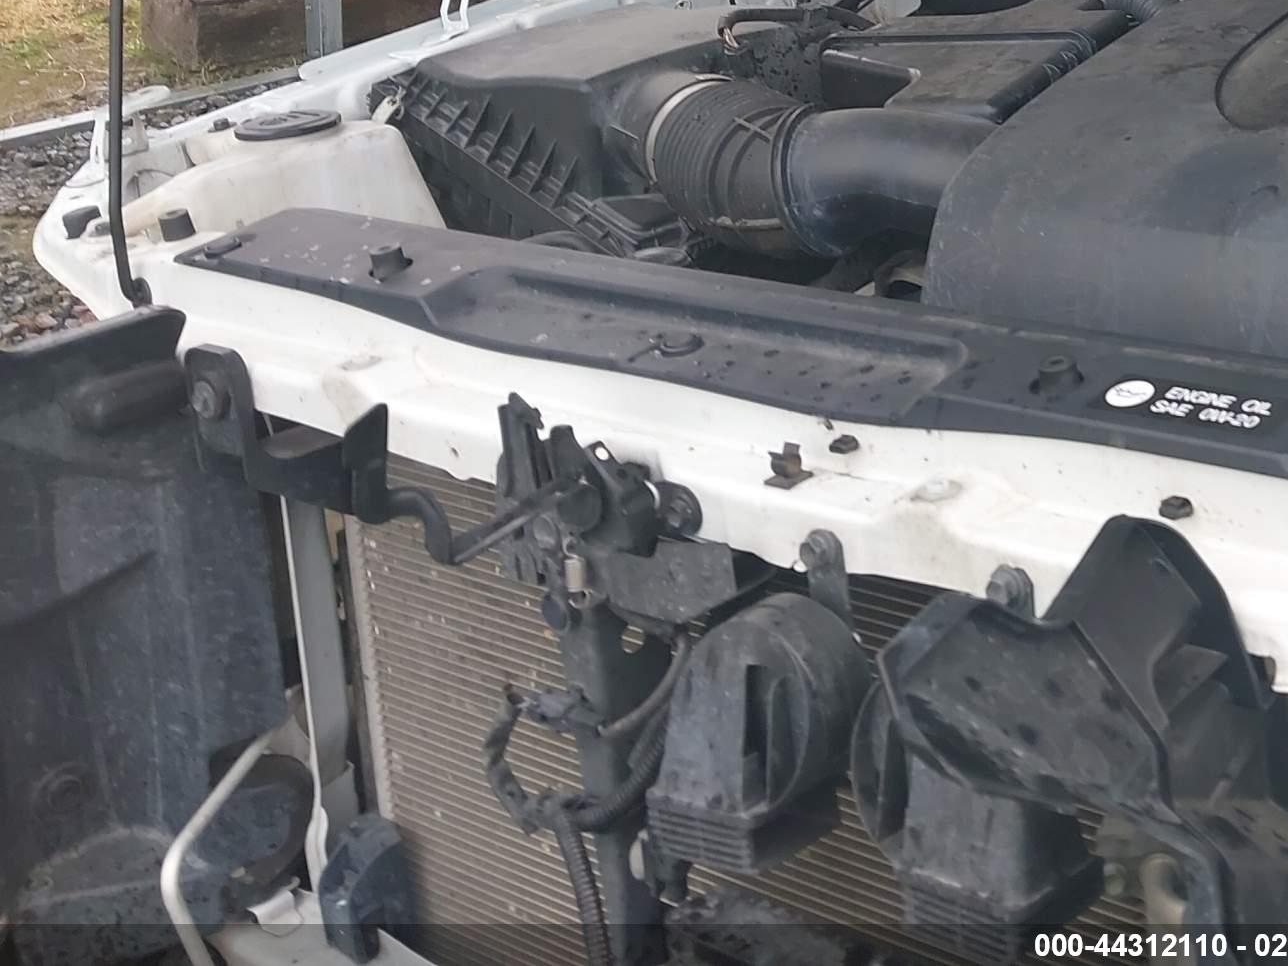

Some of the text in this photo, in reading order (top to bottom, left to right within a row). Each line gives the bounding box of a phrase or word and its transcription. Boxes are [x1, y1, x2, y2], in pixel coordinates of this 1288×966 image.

[1149, 399, 1195, 417] SAE
[1164, 386, 1272, 416] ENGINE OIL
